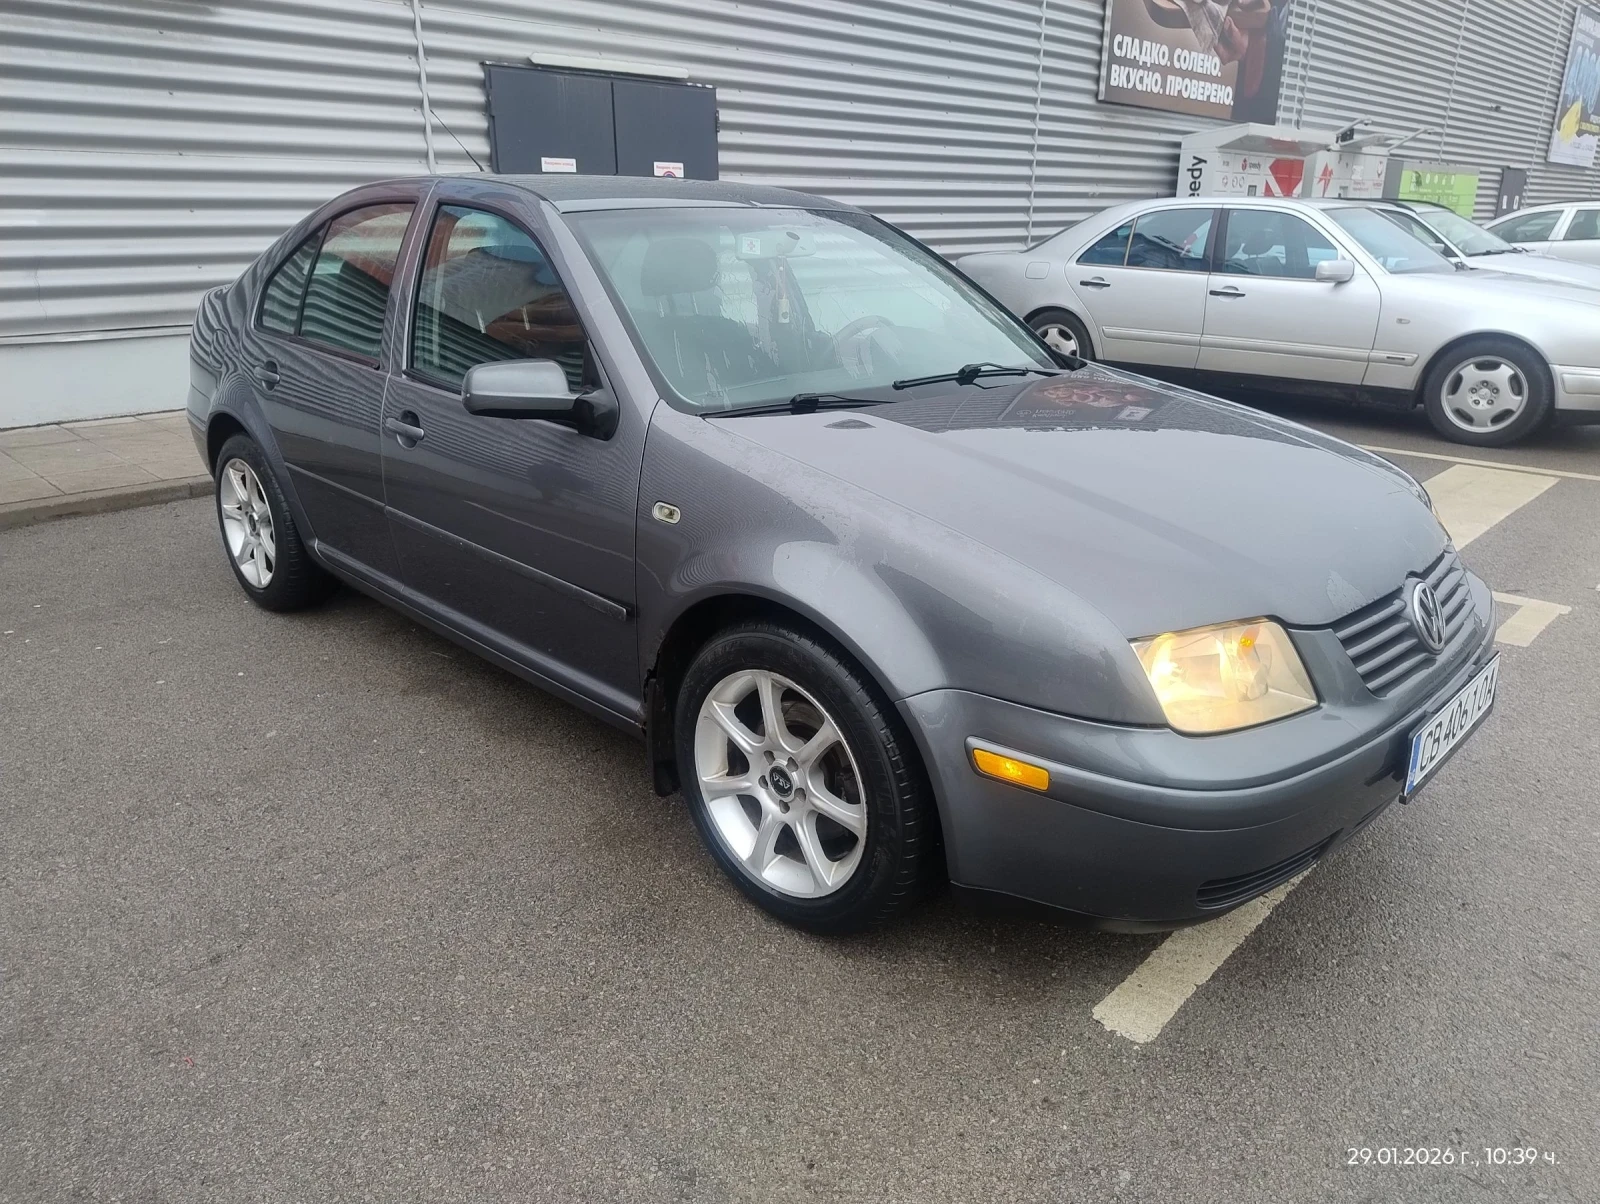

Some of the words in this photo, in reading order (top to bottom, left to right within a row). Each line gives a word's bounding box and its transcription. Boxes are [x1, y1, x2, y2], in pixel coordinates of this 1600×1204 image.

[1113, 34, 1170, 67] СЛАДКО.
[1173, 48, 1221, 77] СОЛЕНО.
[1110, 65, 1163, 95] ВКУСНО.
[1166, 75, 1234, 106] ПРОВЕРЕНО.
[1420, 720, 1443, 772] CB
[1443, 684, 1478, 746] 4061
[1478, 667, 1496, 712] OA
